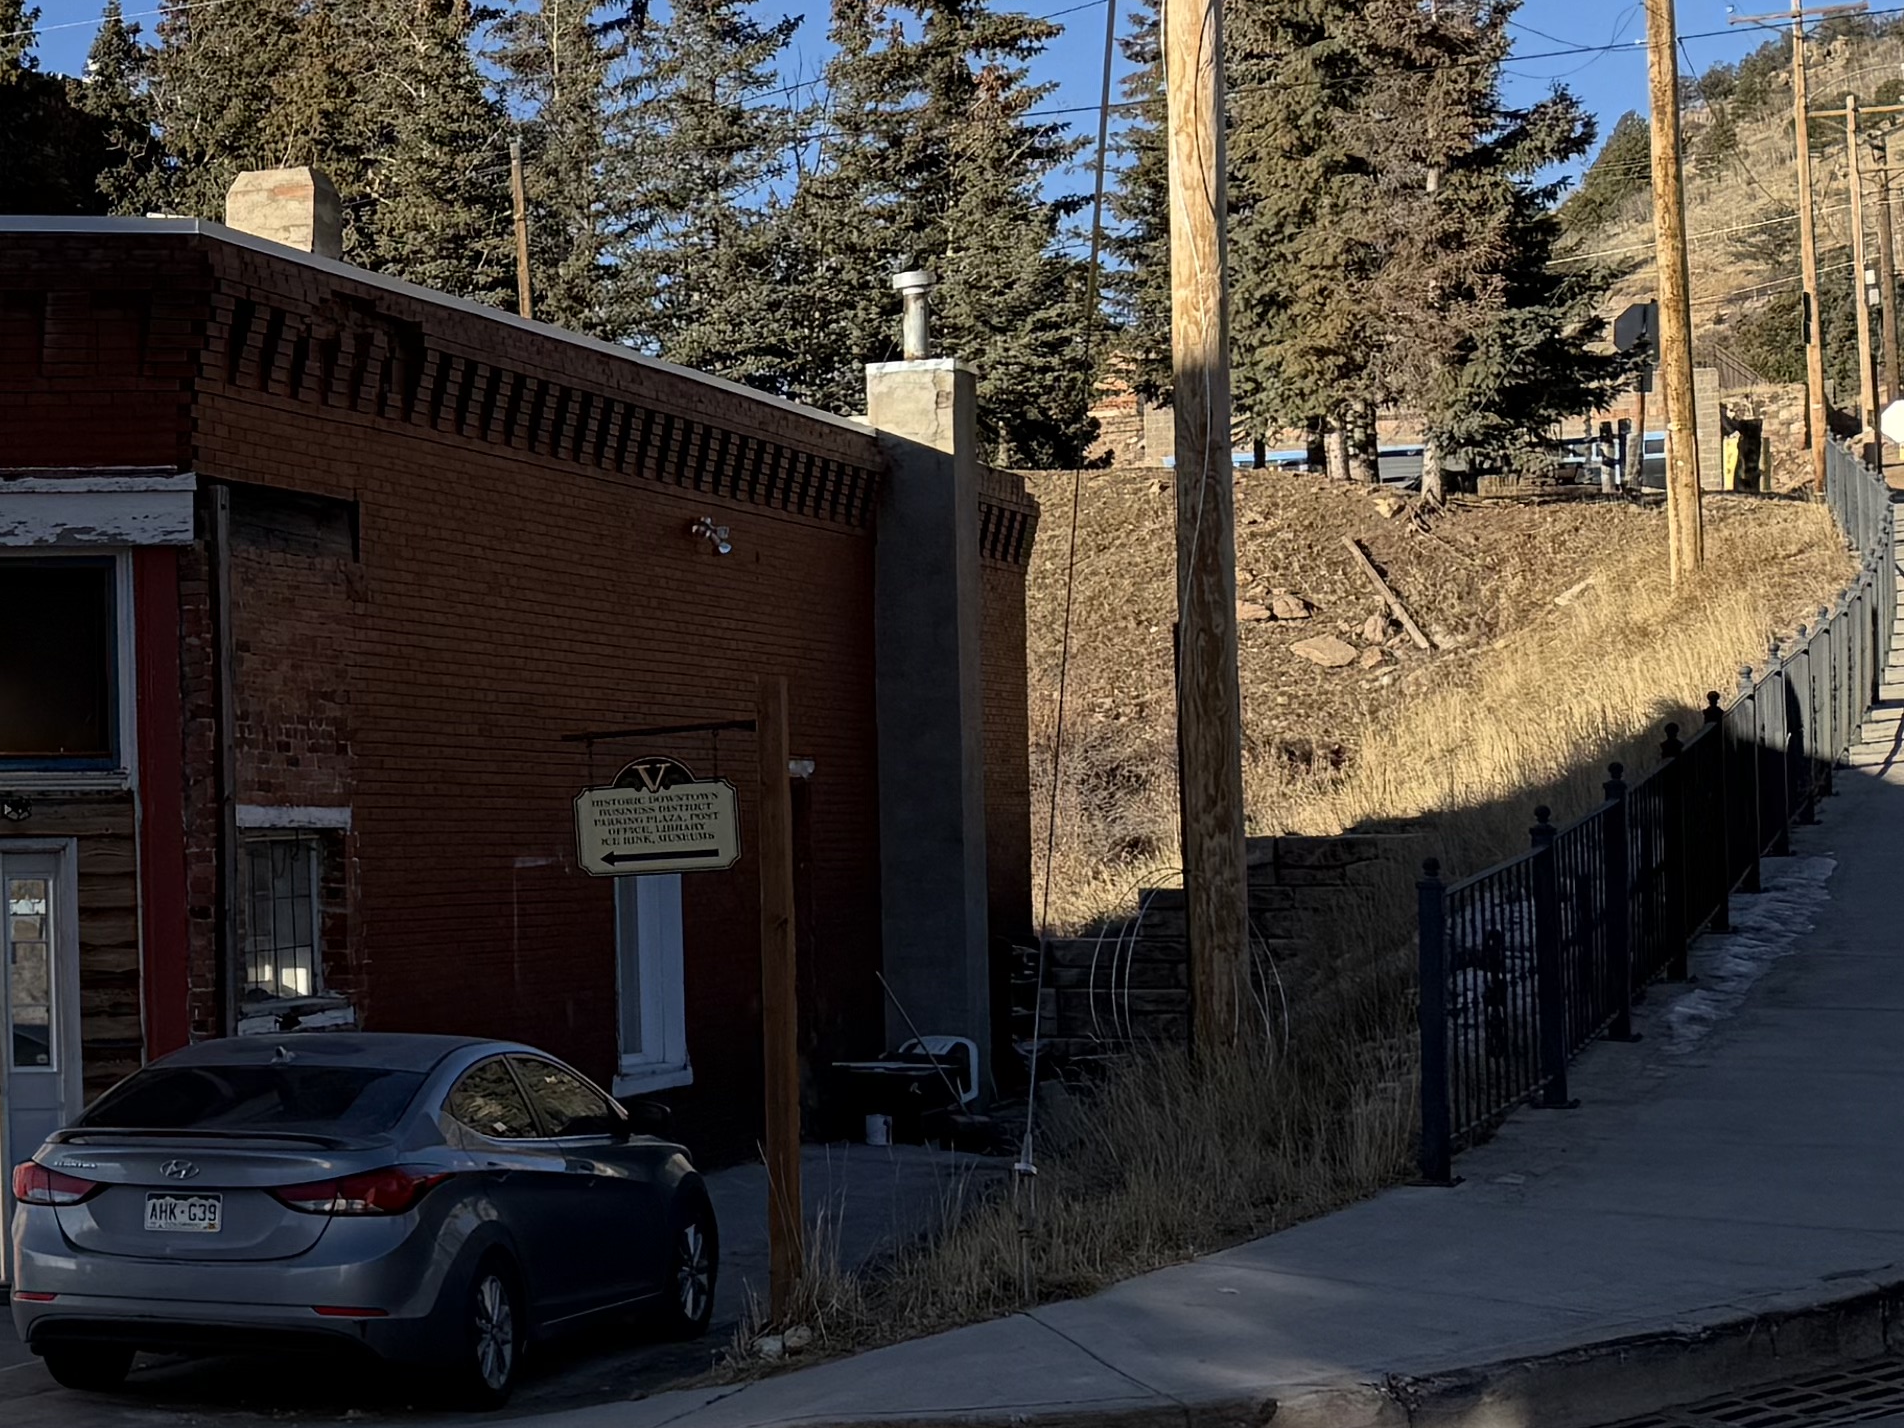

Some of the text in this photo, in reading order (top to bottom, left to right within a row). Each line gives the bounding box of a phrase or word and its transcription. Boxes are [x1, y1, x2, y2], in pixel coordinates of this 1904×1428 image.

[632, 763, 671, 791] V
[592, 792, 719, 807] HISTORIC DOWNTOWN
[599, 802, 713, 817] BUSINESS DISTRICT
[594, 816, 643, 827] PARKING
[690, 812, 719, 821] POST
[656, 823, 705, 833] LIBRARY
